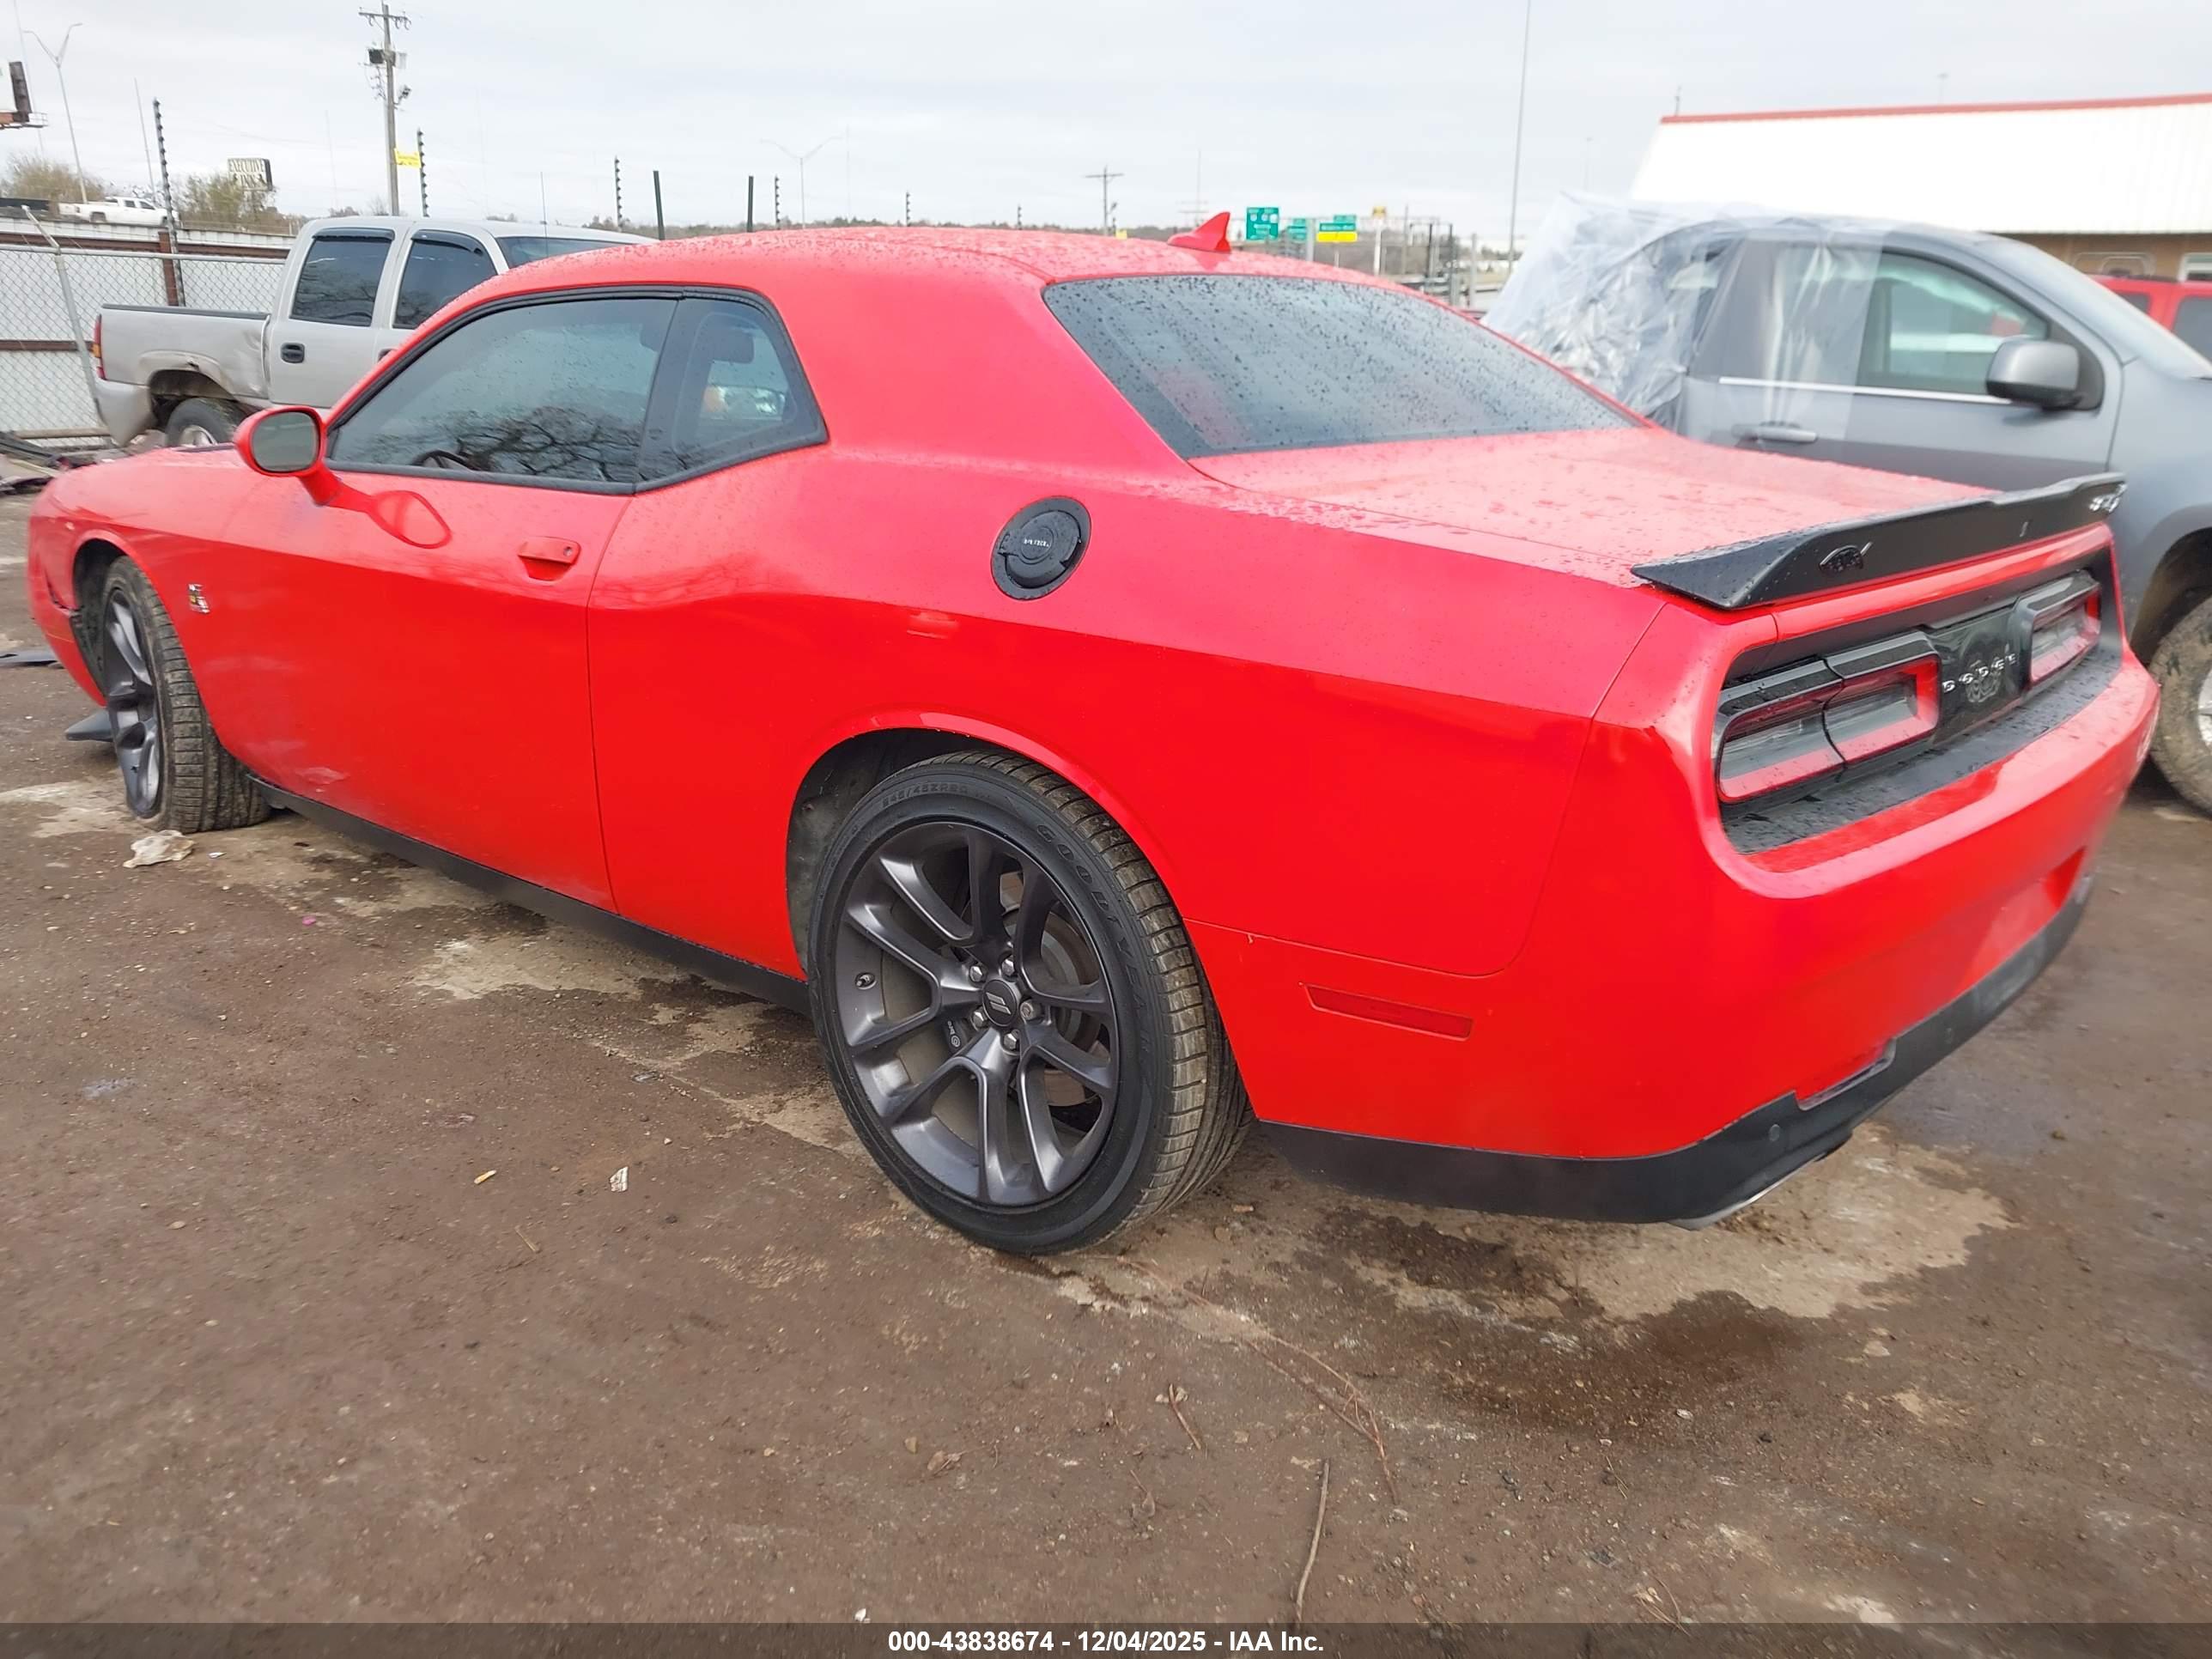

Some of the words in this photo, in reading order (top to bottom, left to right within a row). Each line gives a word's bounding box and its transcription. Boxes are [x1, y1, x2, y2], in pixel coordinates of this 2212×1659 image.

[228, 158, 264, 173] EXECUTIVE
[1942, 653, 2017, 693] DODGE
[1036, 823, 1152, 1054] GOODYEAR
